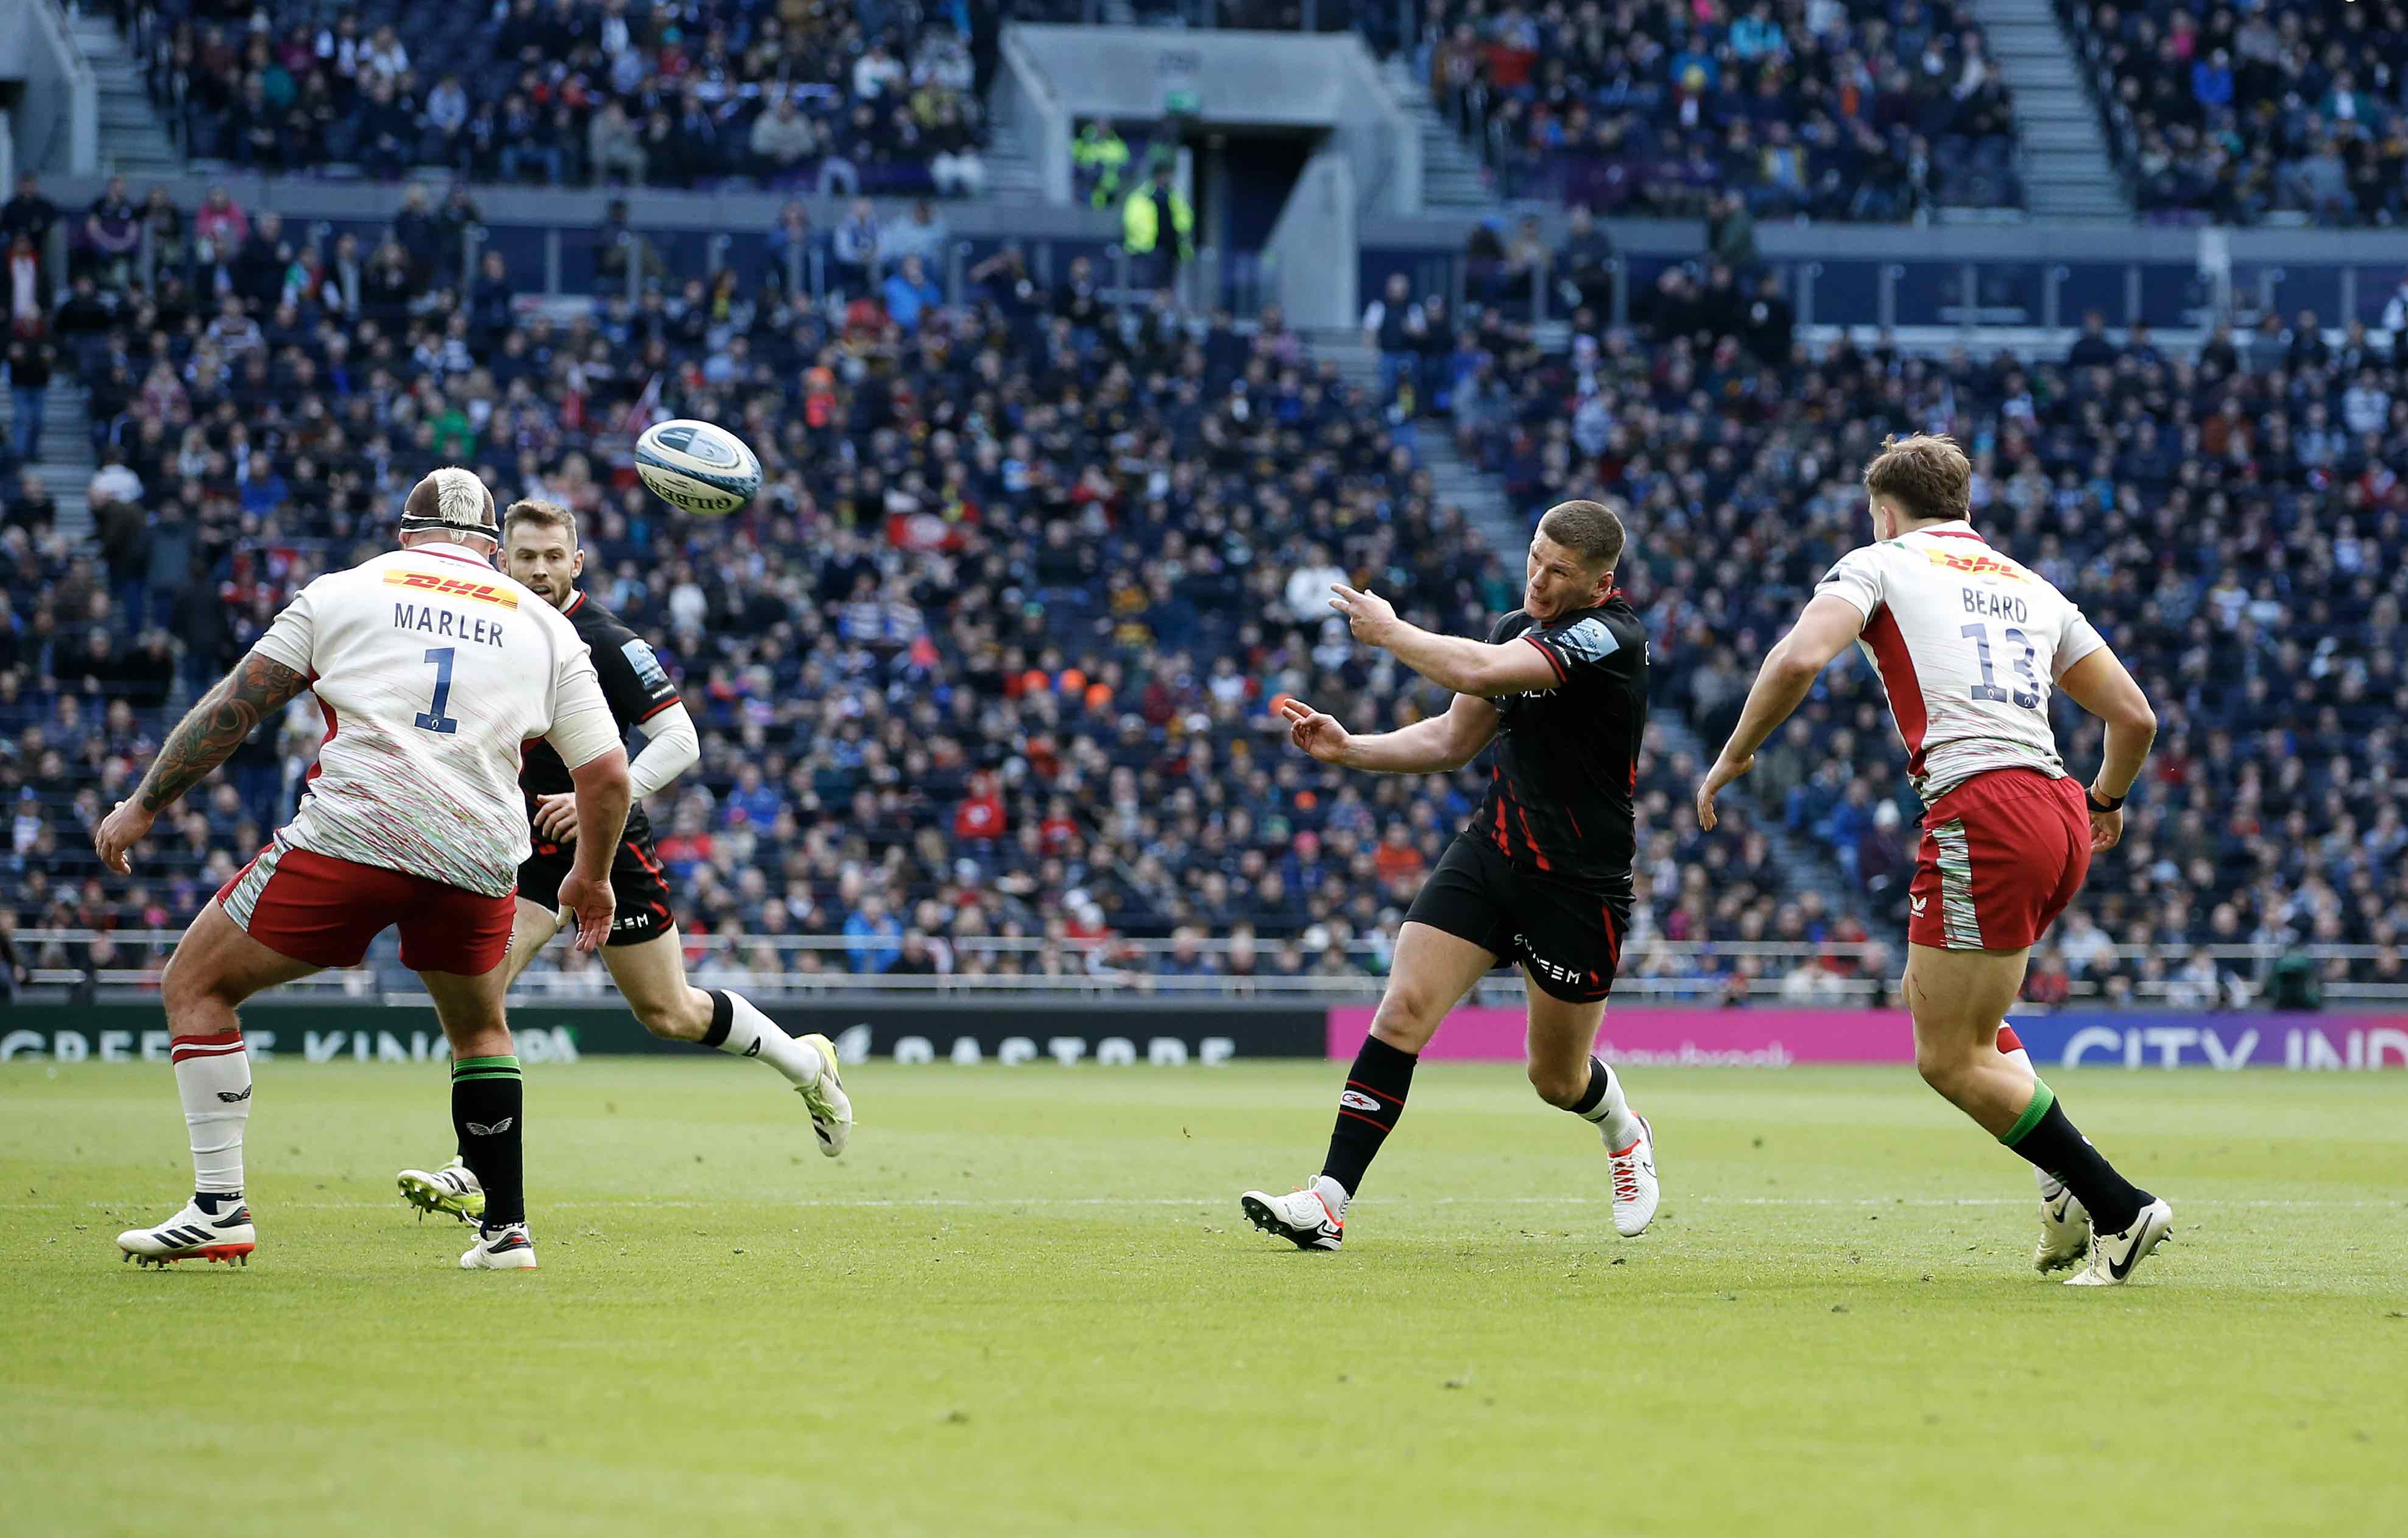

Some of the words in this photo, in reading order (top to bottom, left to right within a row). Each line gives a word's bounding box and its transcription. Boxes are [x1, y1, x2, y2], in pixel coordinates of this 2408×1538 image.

[1944, 554, 2020, 579] DHL
[403, 573, 501, 603] DHL
[1961, 587, 2028, 624] BEARD
[394, 602, 504, 648] MARLER
[1575, 626, 1600, 657] Gallaghr
[1960, 623, 2041, 710] 13
[414, 647, 458, 735] 1
[1, 1029, 277, 1063] GREEE
[303, 1029, 453, 1063] KIN
